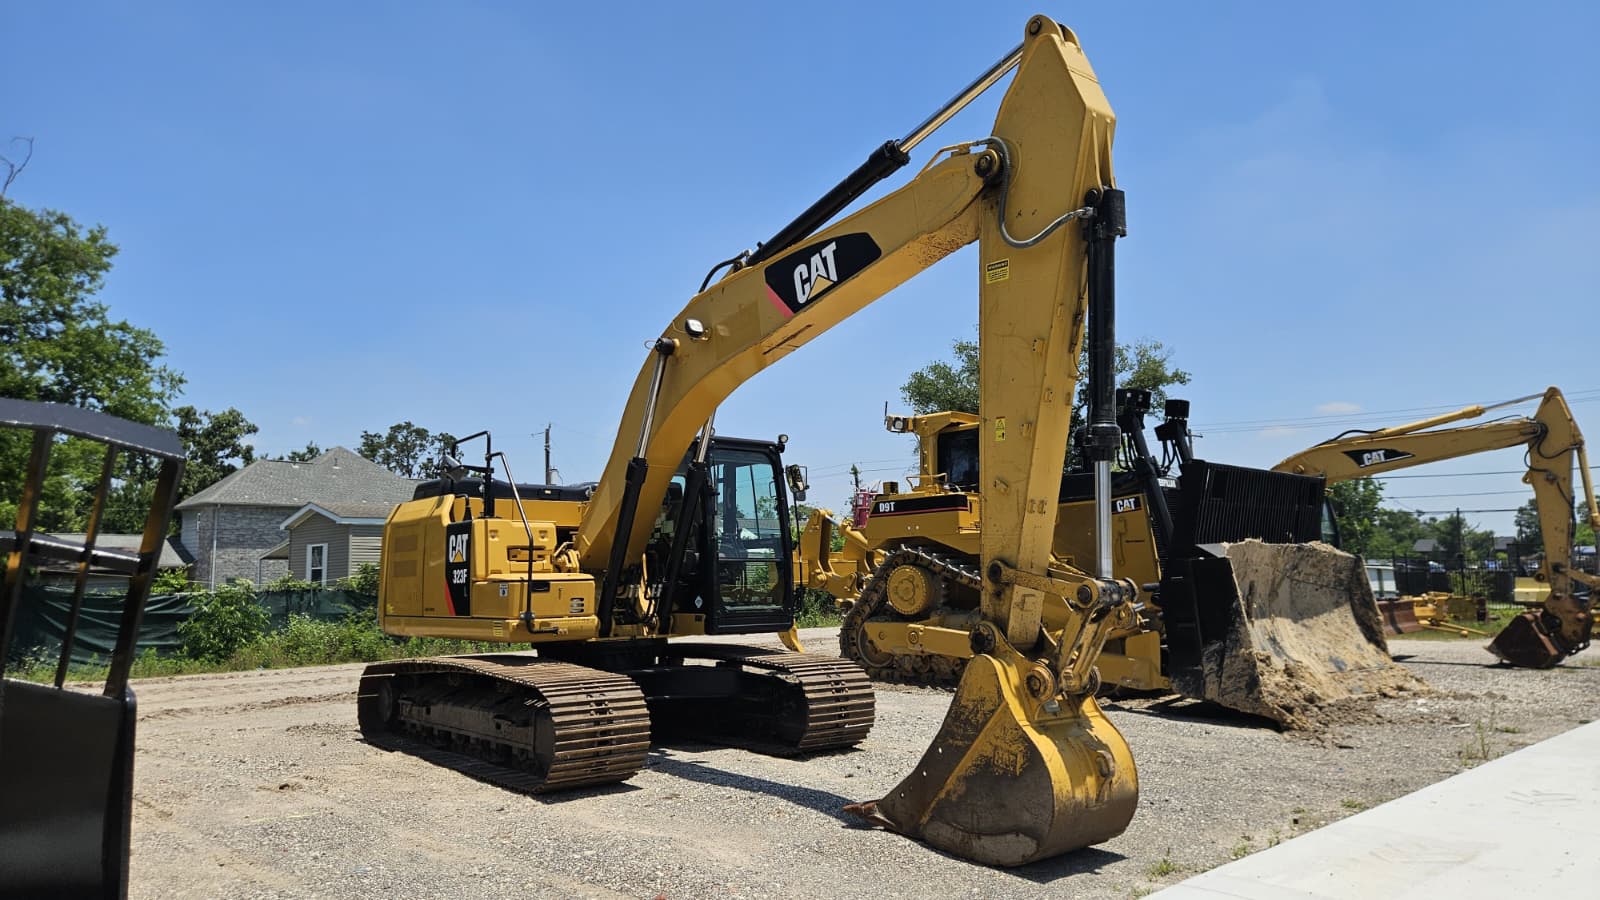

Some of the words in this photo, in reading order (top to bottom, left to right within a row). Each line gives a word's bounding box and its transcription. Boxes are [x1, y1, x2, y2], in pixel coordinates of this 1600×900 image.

[794, 241, 838, 303] CAT
[1363, 450, 1385, 465] CAT
[879, 502, 895, 512] D9T
[1116, 498, 1136, 512] CAT
[449, 534, 469, 563] CAT
[452, 569, 468, 584] 323F
